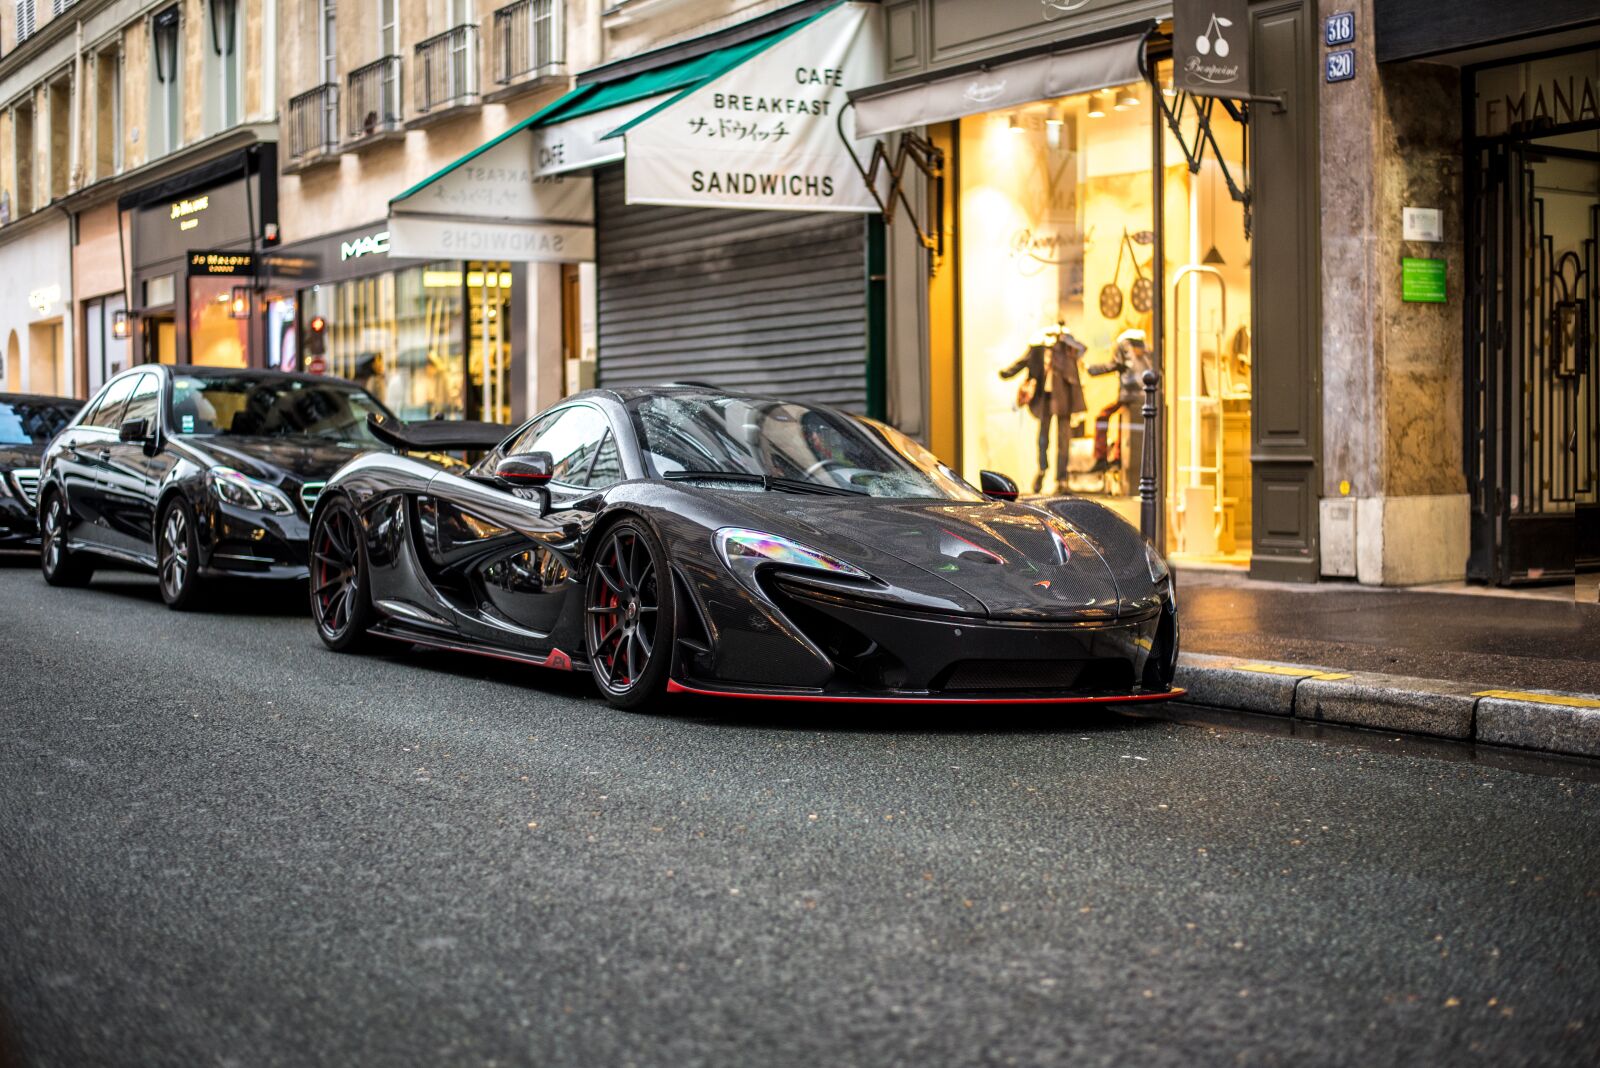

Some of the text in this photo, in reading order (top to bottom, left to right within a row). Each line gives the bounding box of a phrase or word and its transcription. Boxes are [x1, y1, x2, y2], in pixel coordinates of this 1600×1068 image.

[1328, 17, 1350, 41] 318
[1329, 54, 1351, 77] 320
[714, 93, 831, 116] BREAKFAST
[691, 171, 834, 197] SANDWICHS
[341, 231, 391, 261] MAC
